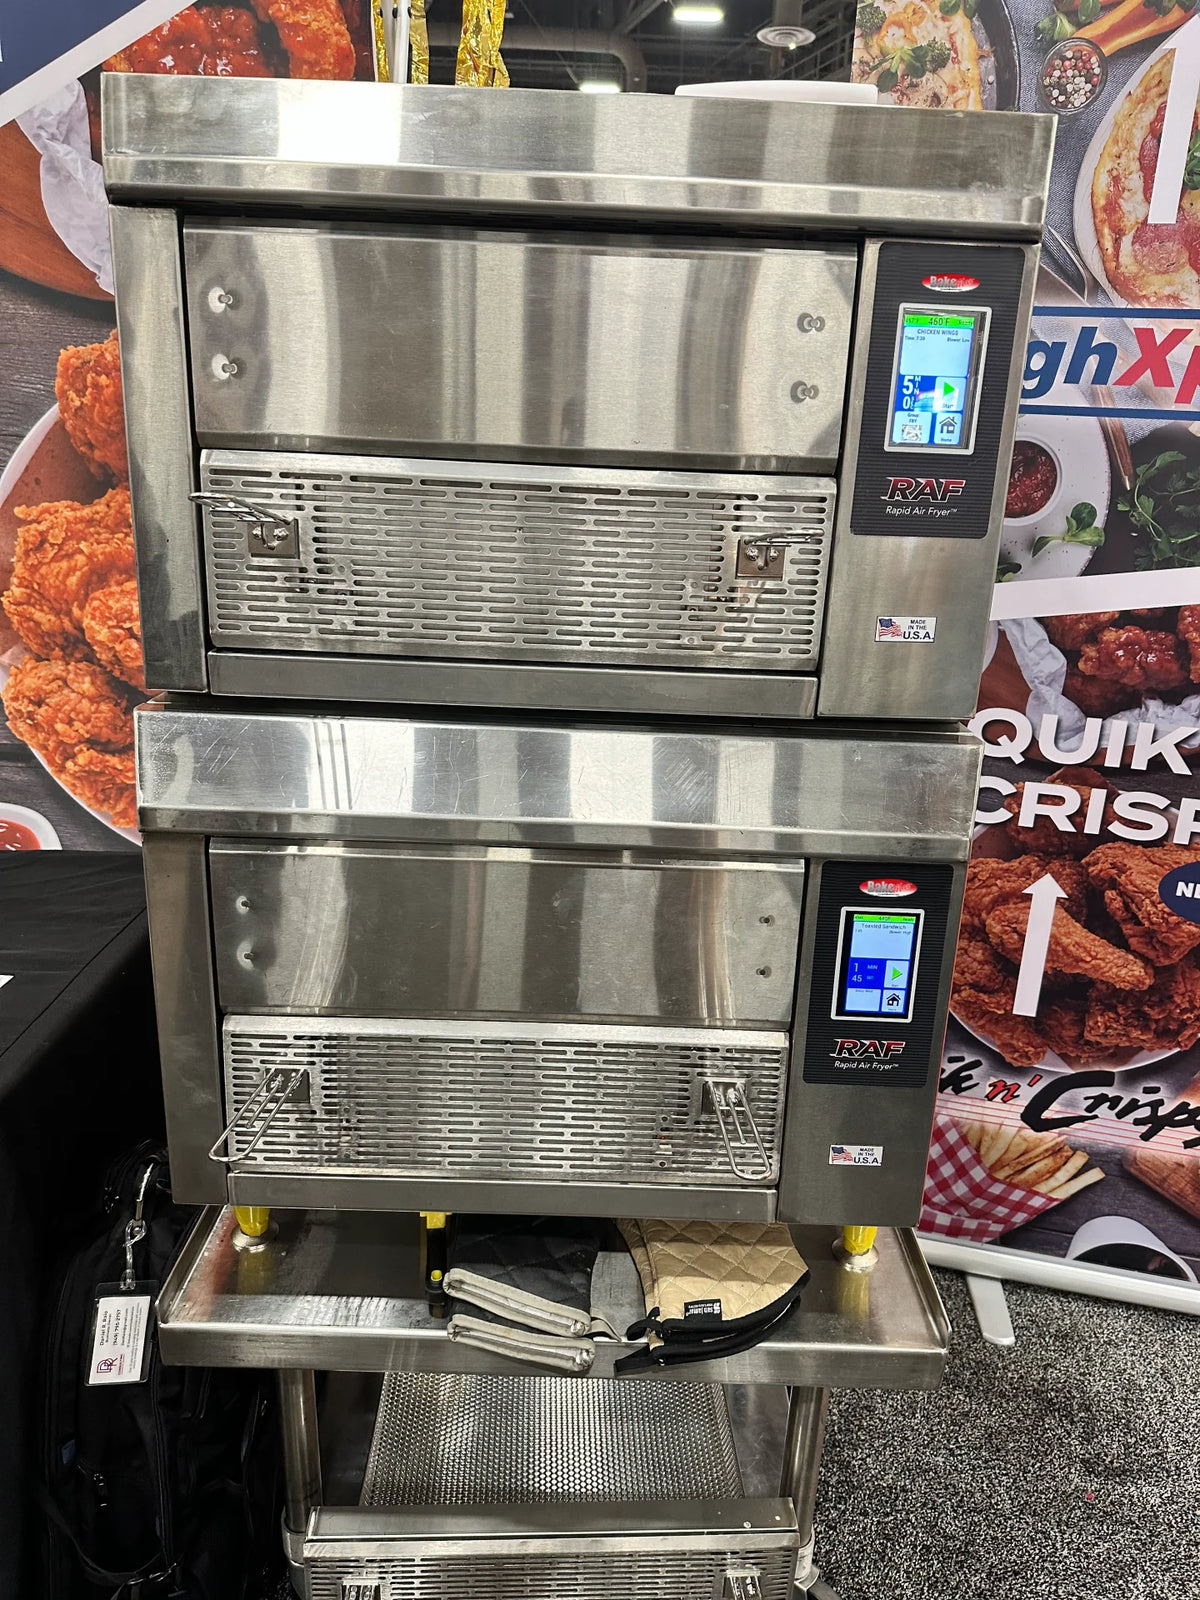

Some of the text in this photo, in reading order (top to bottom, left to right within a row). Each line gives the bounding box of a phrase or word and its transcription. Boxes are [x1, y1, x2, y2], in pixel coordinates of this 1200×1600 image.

[902, 375, 915, 395] 5
[902, 395, 911, 410] 0
[880, 477, 966, 503] RAF
[885, 505, 911, 516] Rapid
[912, 506, 925, 515] Air
[967, 707, 1200, 776] QUIK
[853, 962, 859, 972] 1
[851, 974, 863, 982] 45
[829, 1038, 906, 1060] RAF
[834, 1060, 858, 1070] Rapid
[858, 1061, 870, 1069] Air
